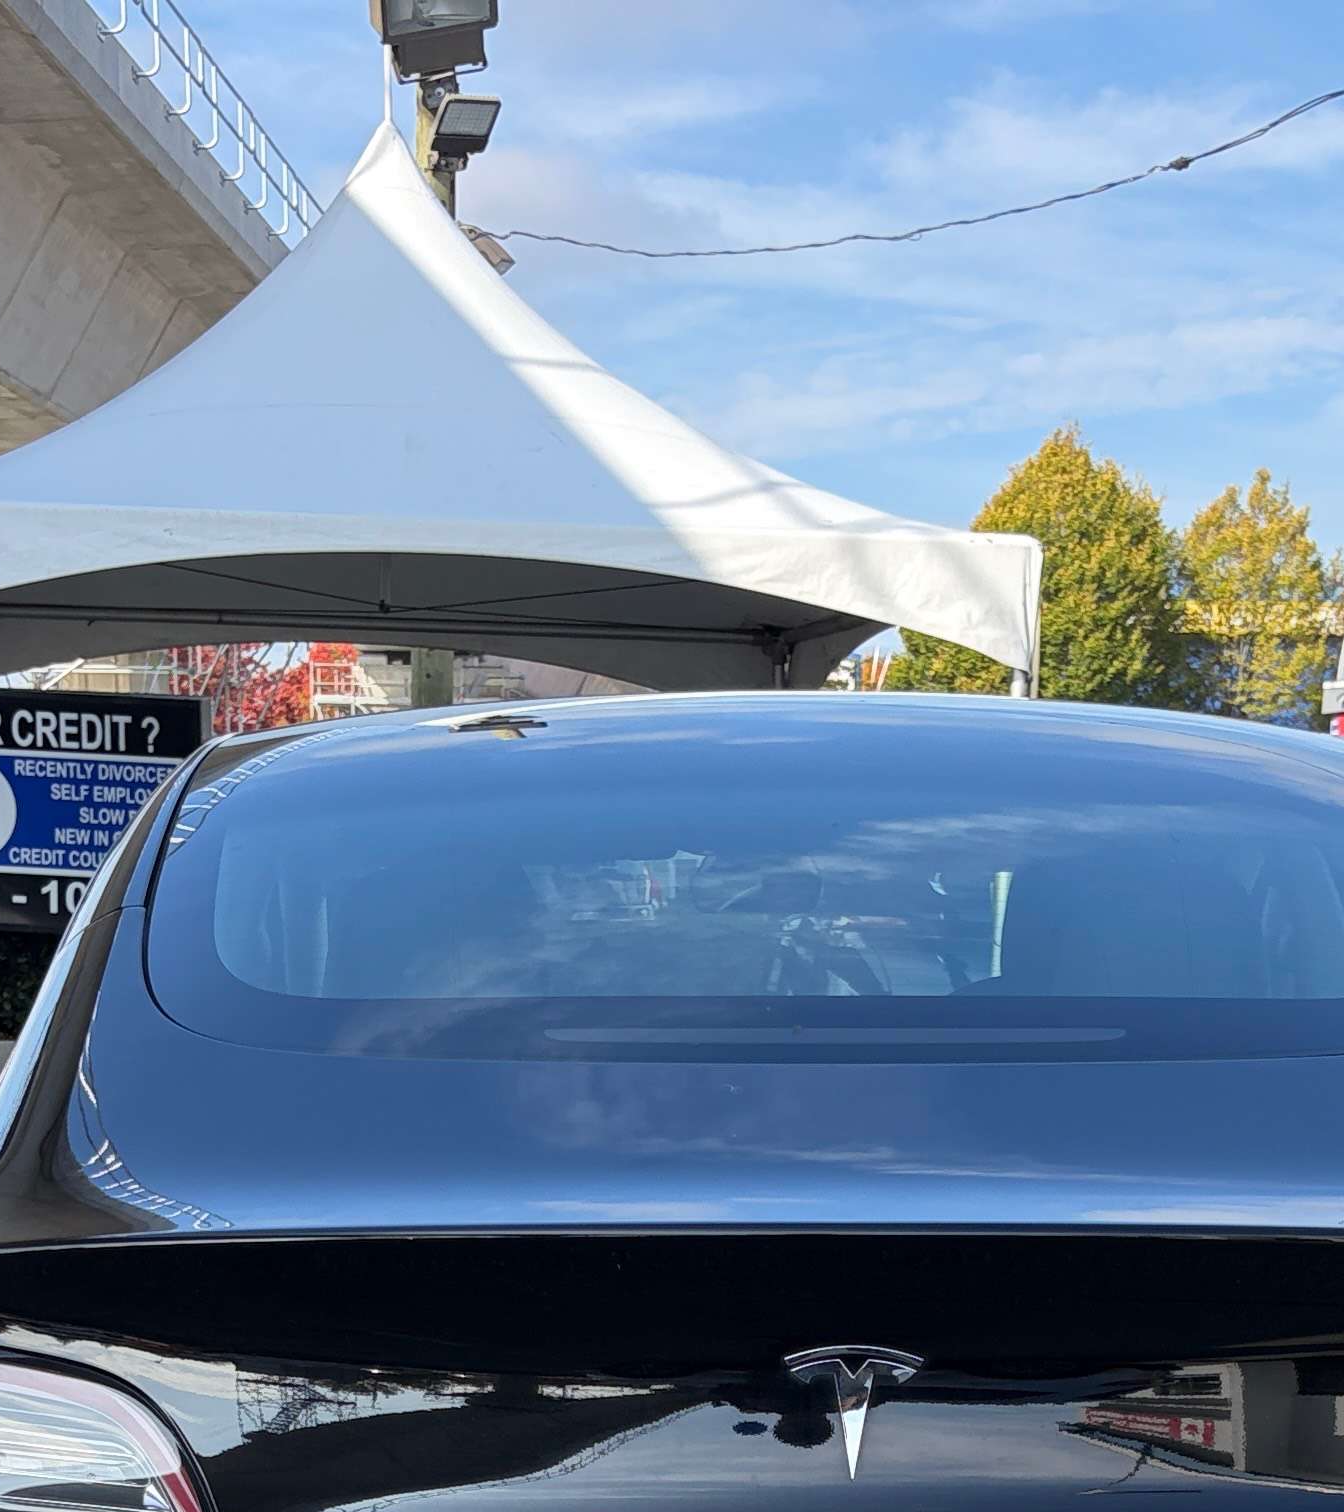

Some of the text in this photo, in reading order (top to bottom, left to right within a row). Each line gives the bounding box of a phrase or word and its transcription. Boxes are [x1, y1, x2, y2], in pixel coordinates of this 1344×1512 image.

[11, 709, 132, 752] CREDIT
[140, 716, 161, 754] ?
[13, 759, 95, 781] RECENTLY
[49, 783, 90, 802] SELF
[79, 806, 125, 826] SLOW
[54, 827, 91, 845] NEW
[93, 830, 109, 846] IN
[8, 847, 106, 868] CREDIT COU
